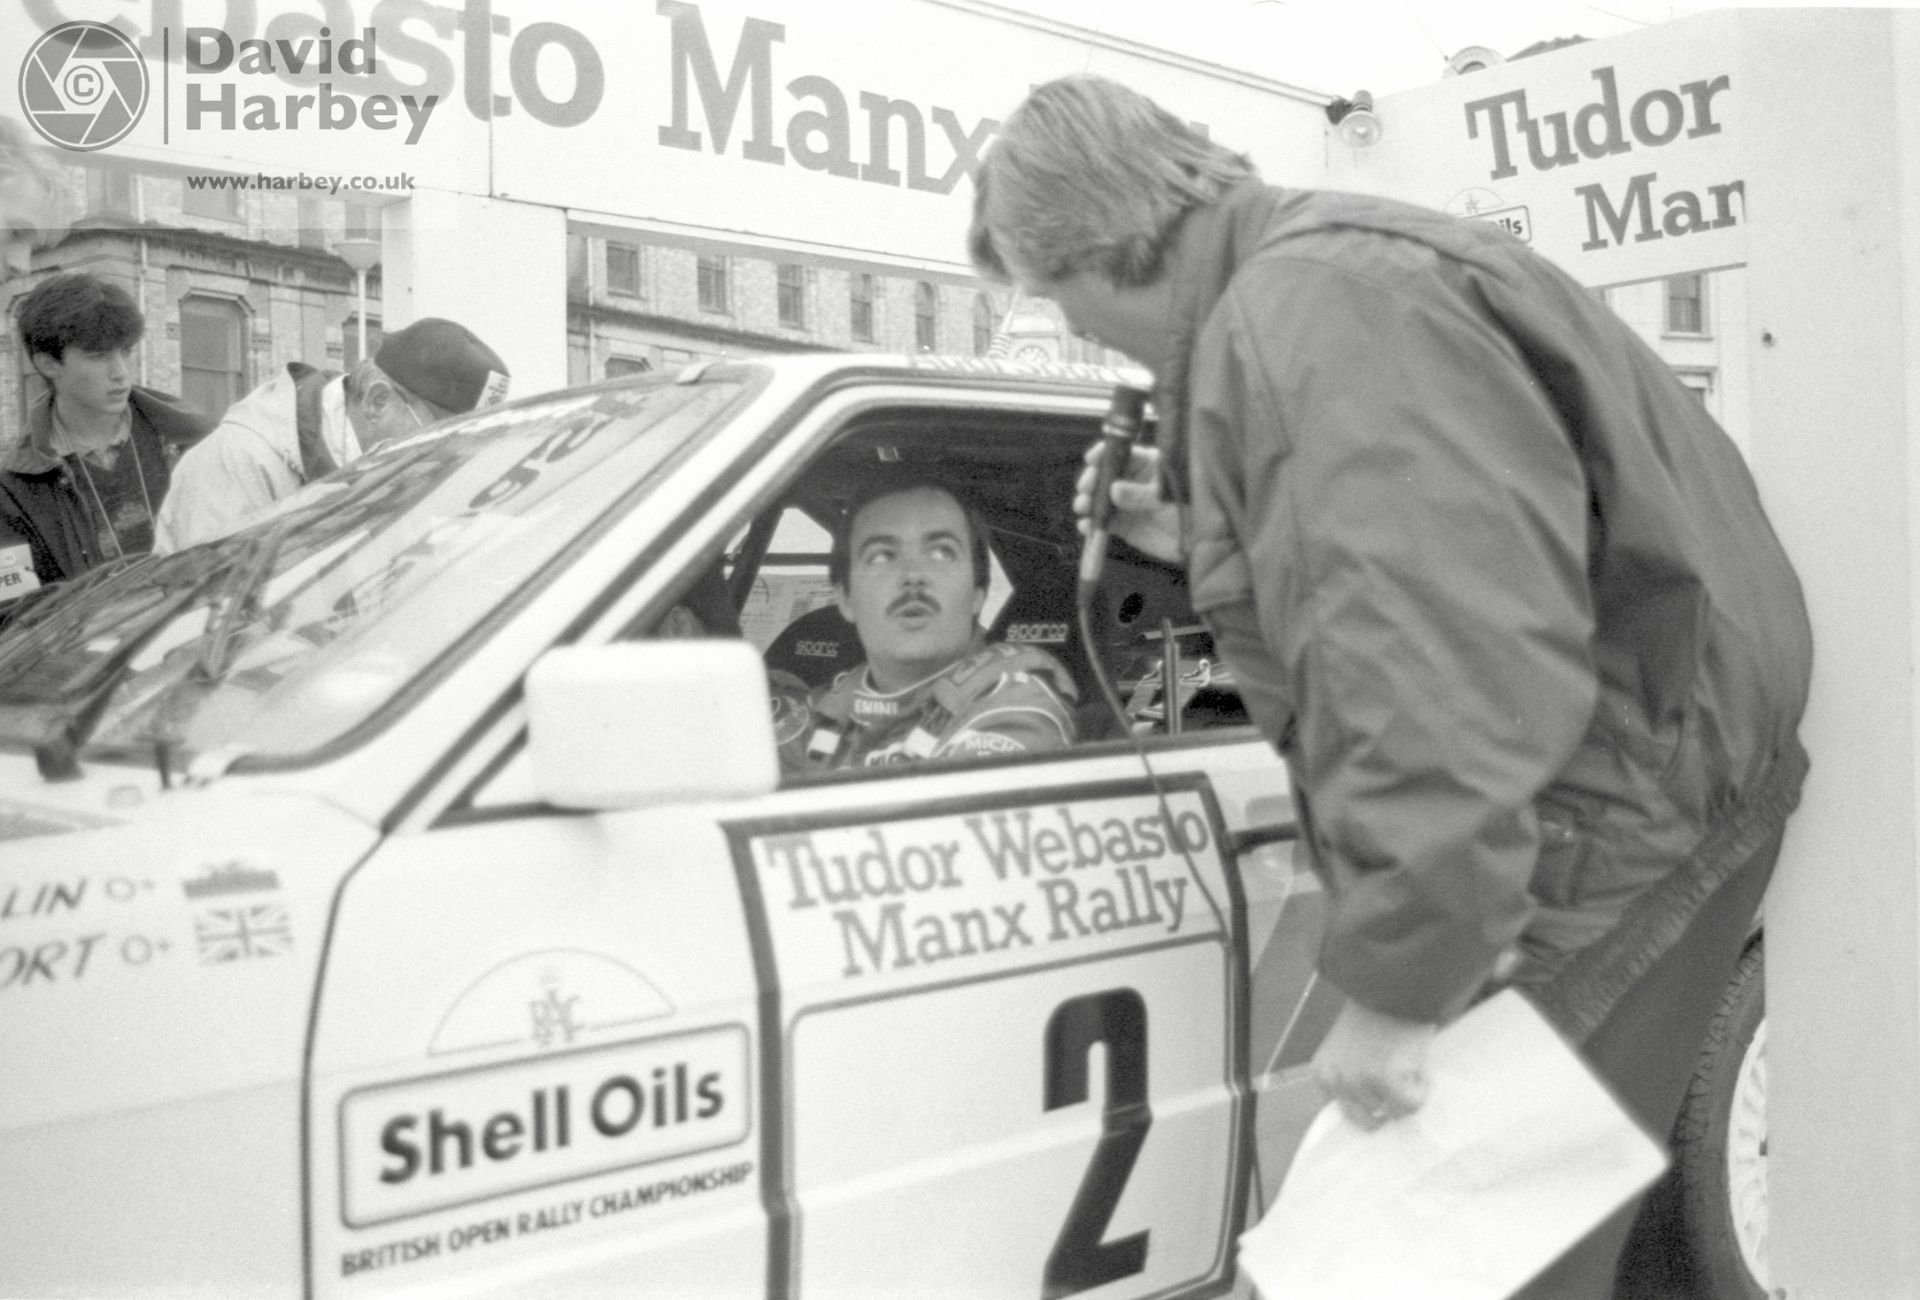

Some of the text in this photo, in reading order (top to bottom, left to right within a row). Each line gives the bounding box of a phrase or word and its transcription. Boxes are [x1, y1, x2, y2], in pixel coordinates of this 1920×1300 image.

[655, 0, 1003, 196] Manx
[1464, 66, 1730, 181] Tudor
[766, 806, 1209, 910] Tudor Webasto
[834, 865, 1189, 979] Manx Rally
[379, 1061, 725, 1185] Shell Oils
[1044, 986, 1153, 1300] 2
[341, 1161, 754, 1278] BRITISH OPEN RALLY CHAMPIONSHIP
